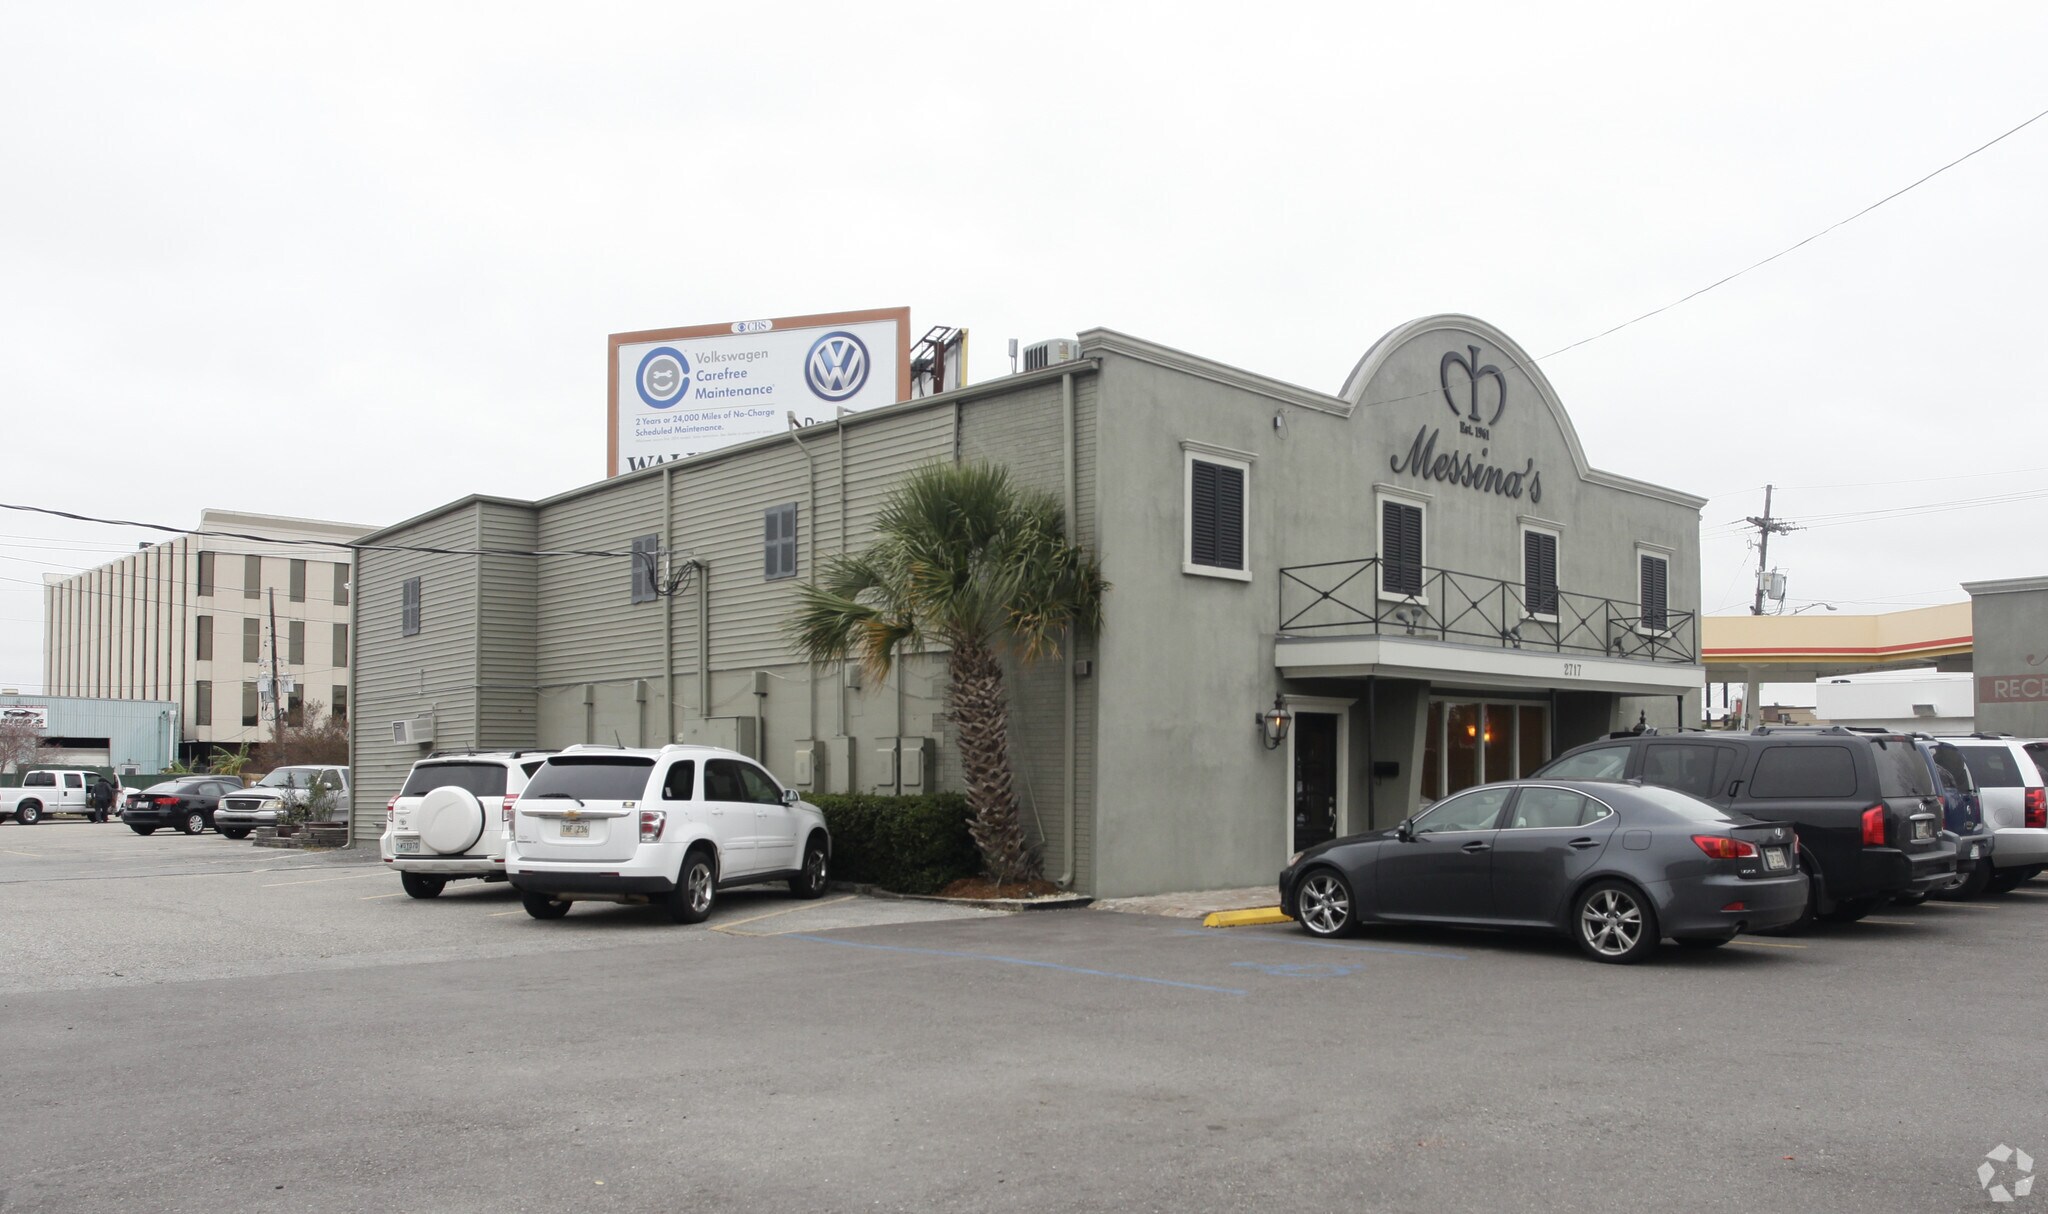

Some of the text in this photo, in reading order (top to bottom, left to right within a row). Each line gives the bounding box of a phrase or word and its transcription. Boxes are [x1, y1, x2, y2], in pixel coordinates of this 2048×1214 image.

[747, 320, 767, 331] CBS
[695, 350, 769, 364] Volkswagen
[696, 367, 748, 382] Carefree
[695, 385, 774, 400] Maintenance
[635, 418, 641, 426] 2
[642, 417, 662, 426] Years
[672, 413, 700, 424] 24,000
[701, 411, 721, 421] Miles
[723, 410, 732, 419] of
[733, 408, 775, 418] No-Charge
[635, 425, 672, 437] Scheduled
[674, 423, 725, 435] Maintenance.
[1459, 420, 1474, 436] Est.
[1390, 424, 1542, 503] Messina's
[1563, 663, 1582, 677] 2717
[1994, 678, 2048, 698] RECE
